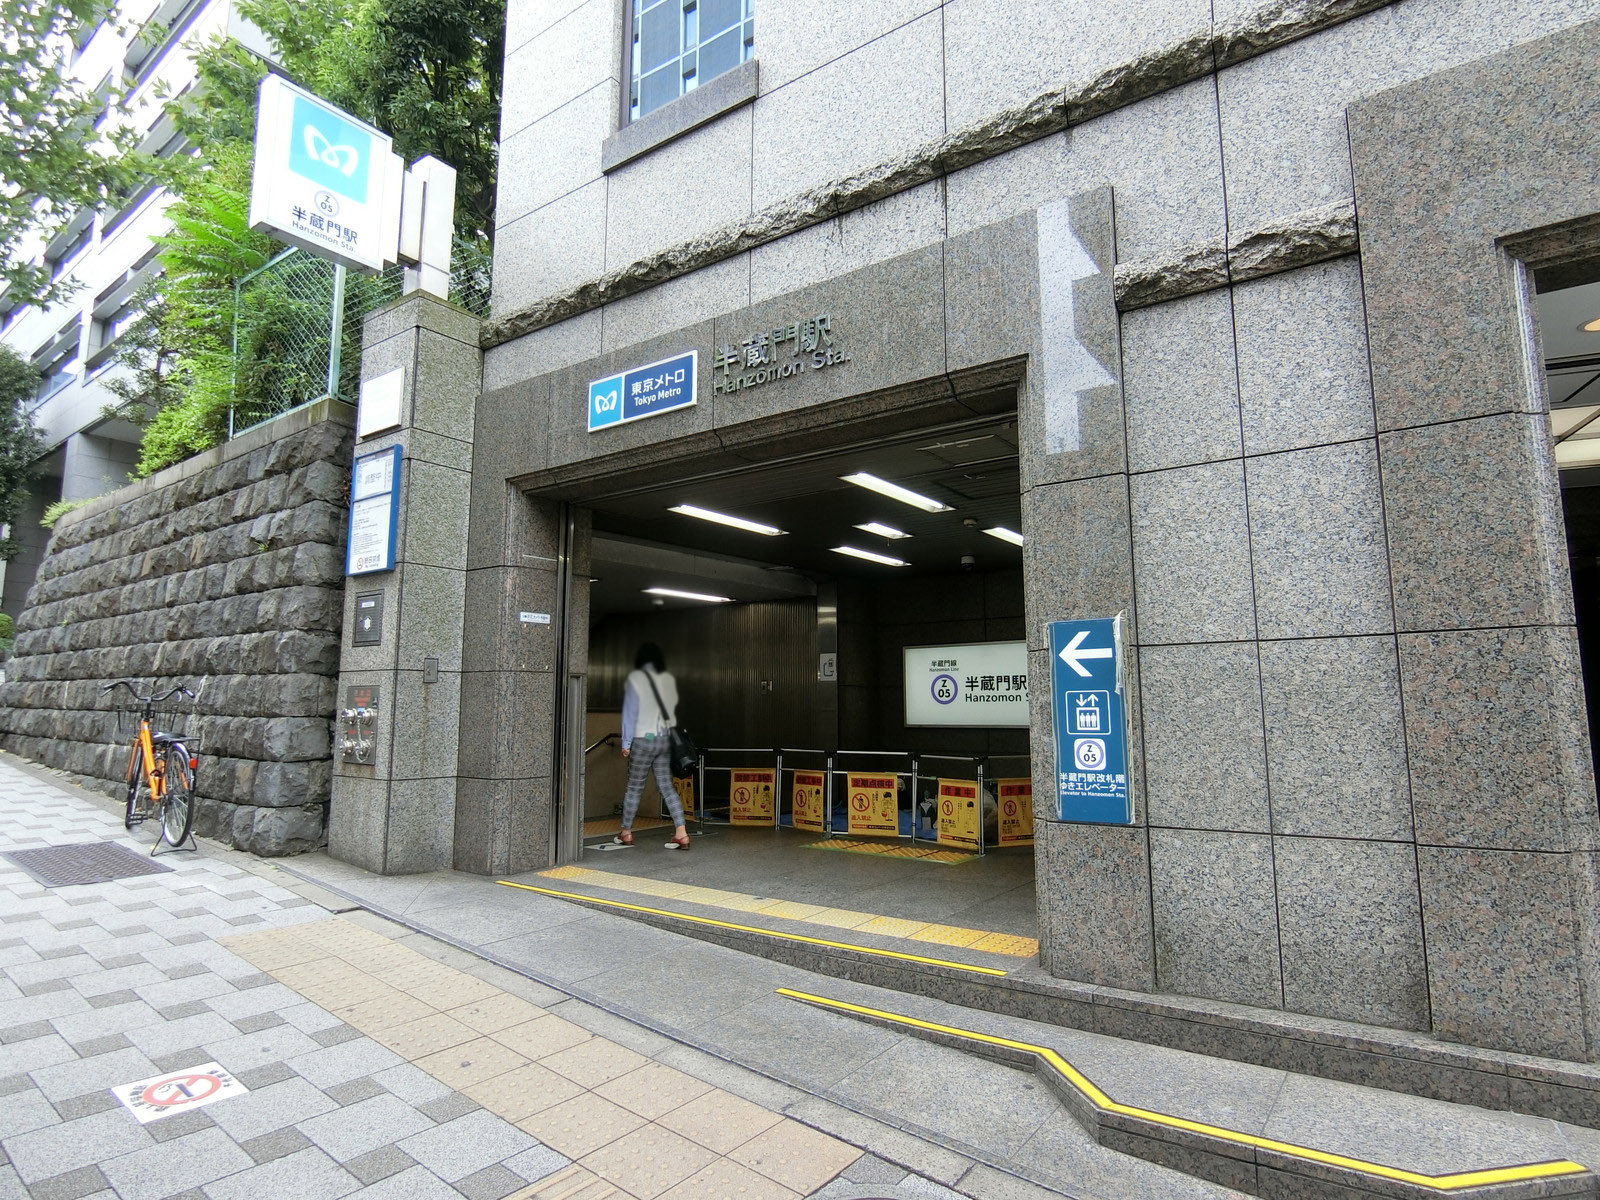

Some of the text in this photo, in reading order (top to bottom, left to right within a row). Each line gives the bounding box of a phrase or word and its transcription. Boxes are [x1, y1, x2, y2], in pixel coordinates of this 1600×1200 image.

[325, 195, 330, 203] Z
[320, 201, 333, 213] 05
[292, 205, 358, 245] 半蔵門駅
[292, 220, 339, 246] Hanzomon
[713, 313, 833, 376] 半蔵門駅
[811, 347, 852, 369] Sta.
[631, 368, 685, 396] 東京メトロ
[634, 387, 682, 407] Tokyo Metro
[931, 659, 957, 668] 半蔵門線
[941, 679, 947, 688] Z
[965, 675, 1027, 691] 半蔵門駅
[938, 689, 951, 698] 05
[965, 693, 1022, 702] Hanzomon
[1087, 744, 1093, 753] Z
[1083, 753, 1097, 762] 05
[1060, 772, 1125, 783] 半蔵門駅改札階
[1060, 781, 1126, 792] ゆきエレベーター
